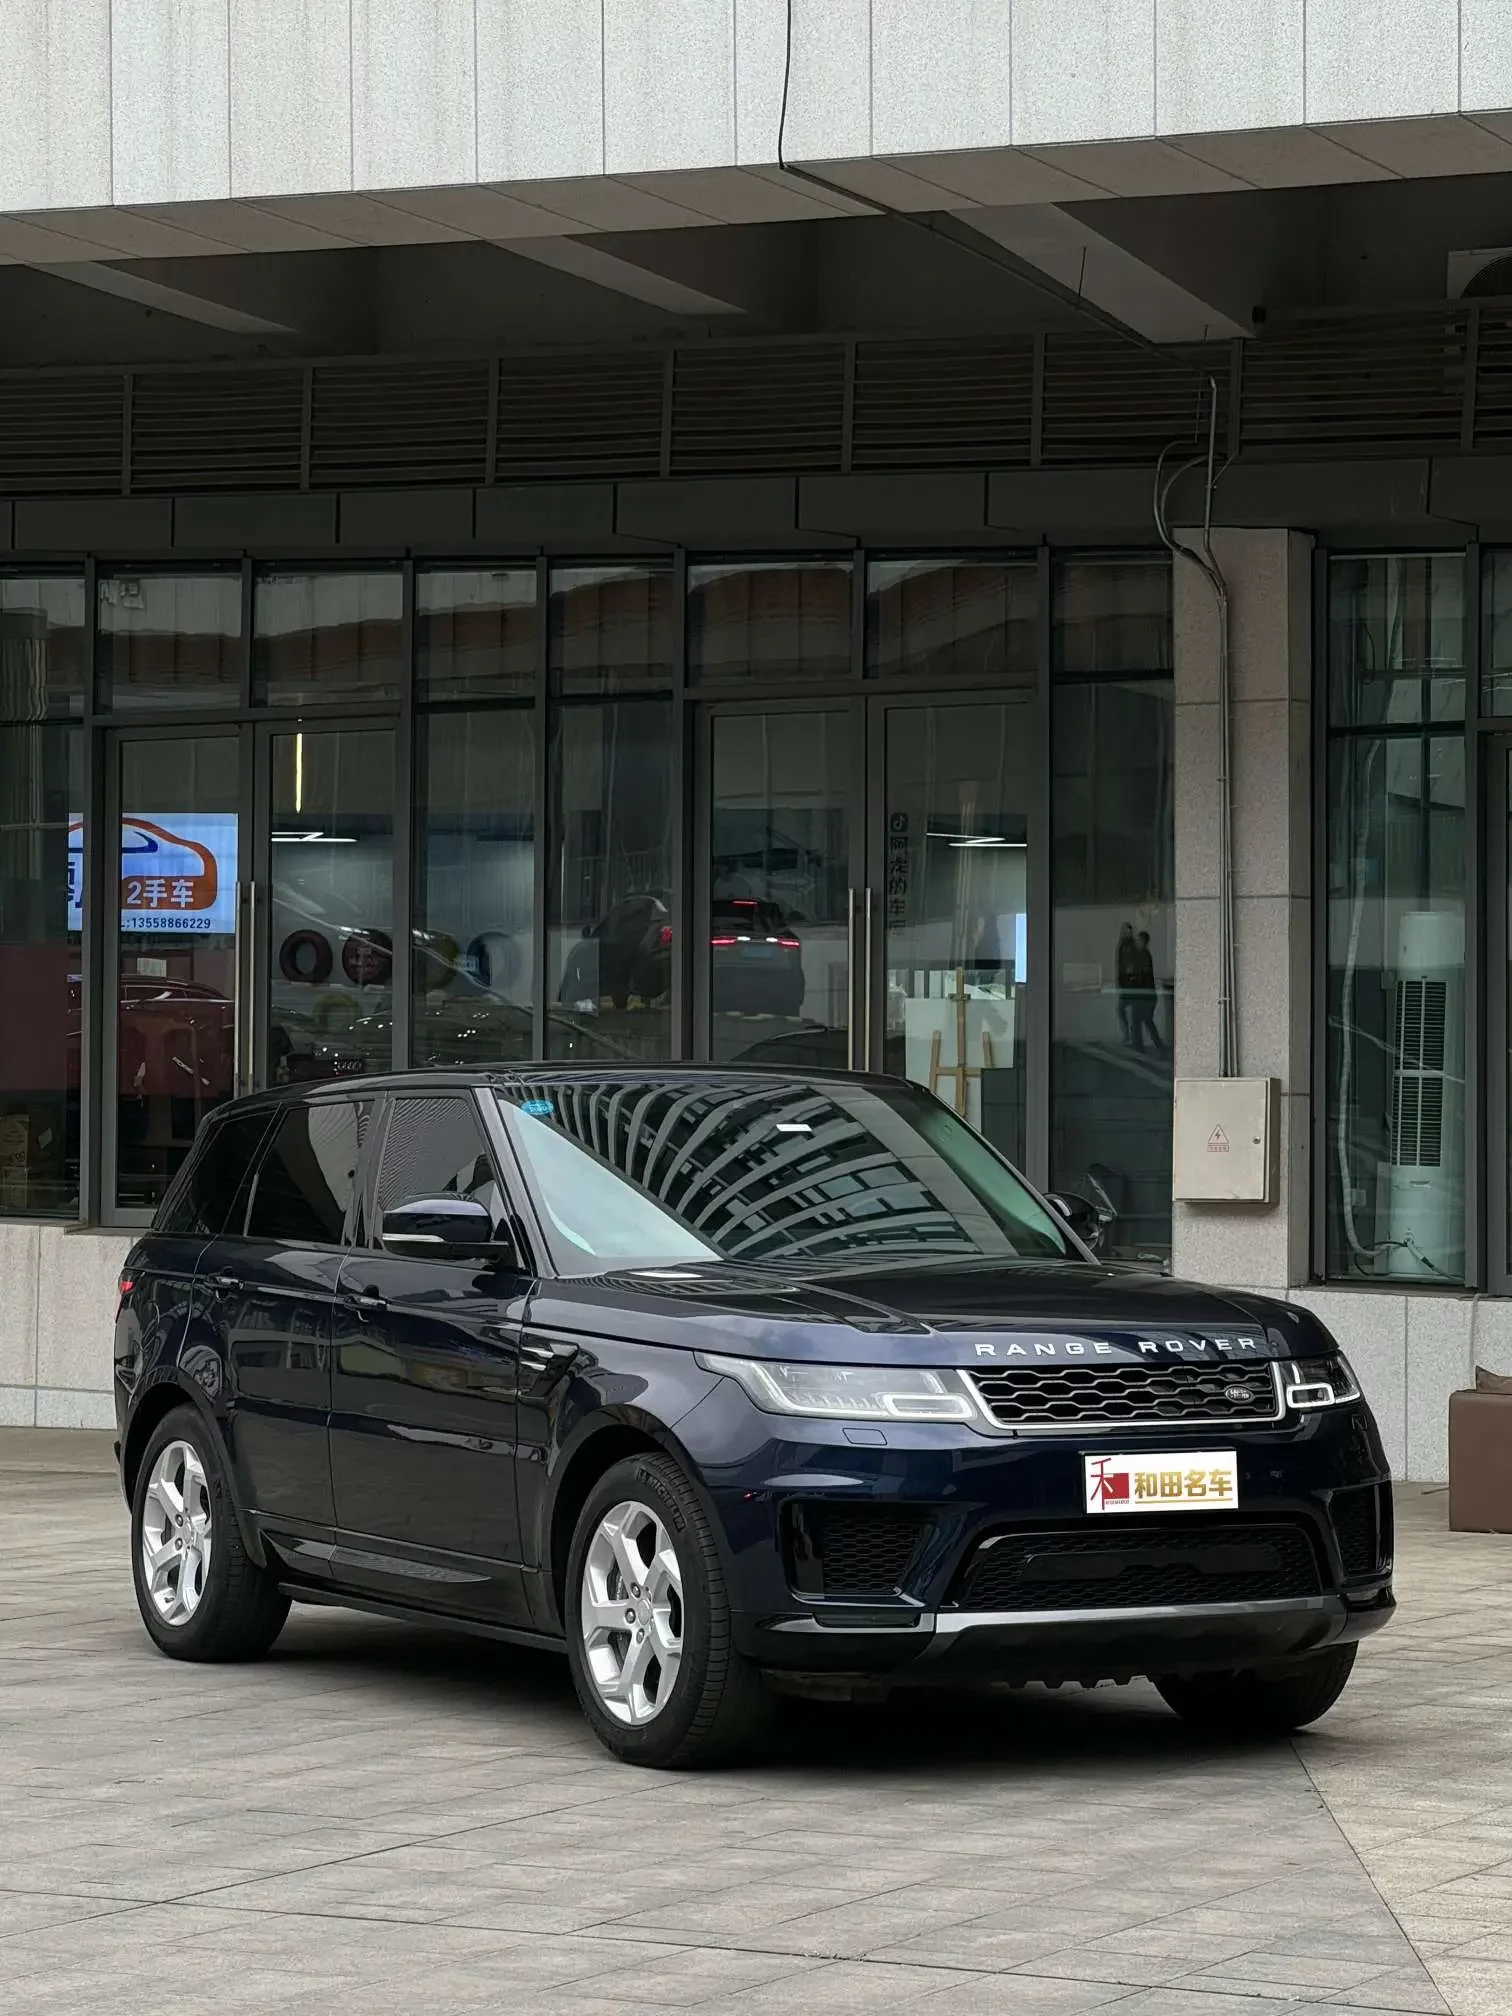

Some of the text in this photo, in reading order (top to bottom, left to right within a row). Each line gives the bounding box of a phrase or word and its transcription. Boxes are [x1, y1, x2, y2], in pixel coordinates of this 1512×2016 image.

[126, 879, 194, 908] 2手车
[974, 1338, 1258, 1356] RANGE ROVER
[1134, 1469, 1233, 1499] 和田名车
